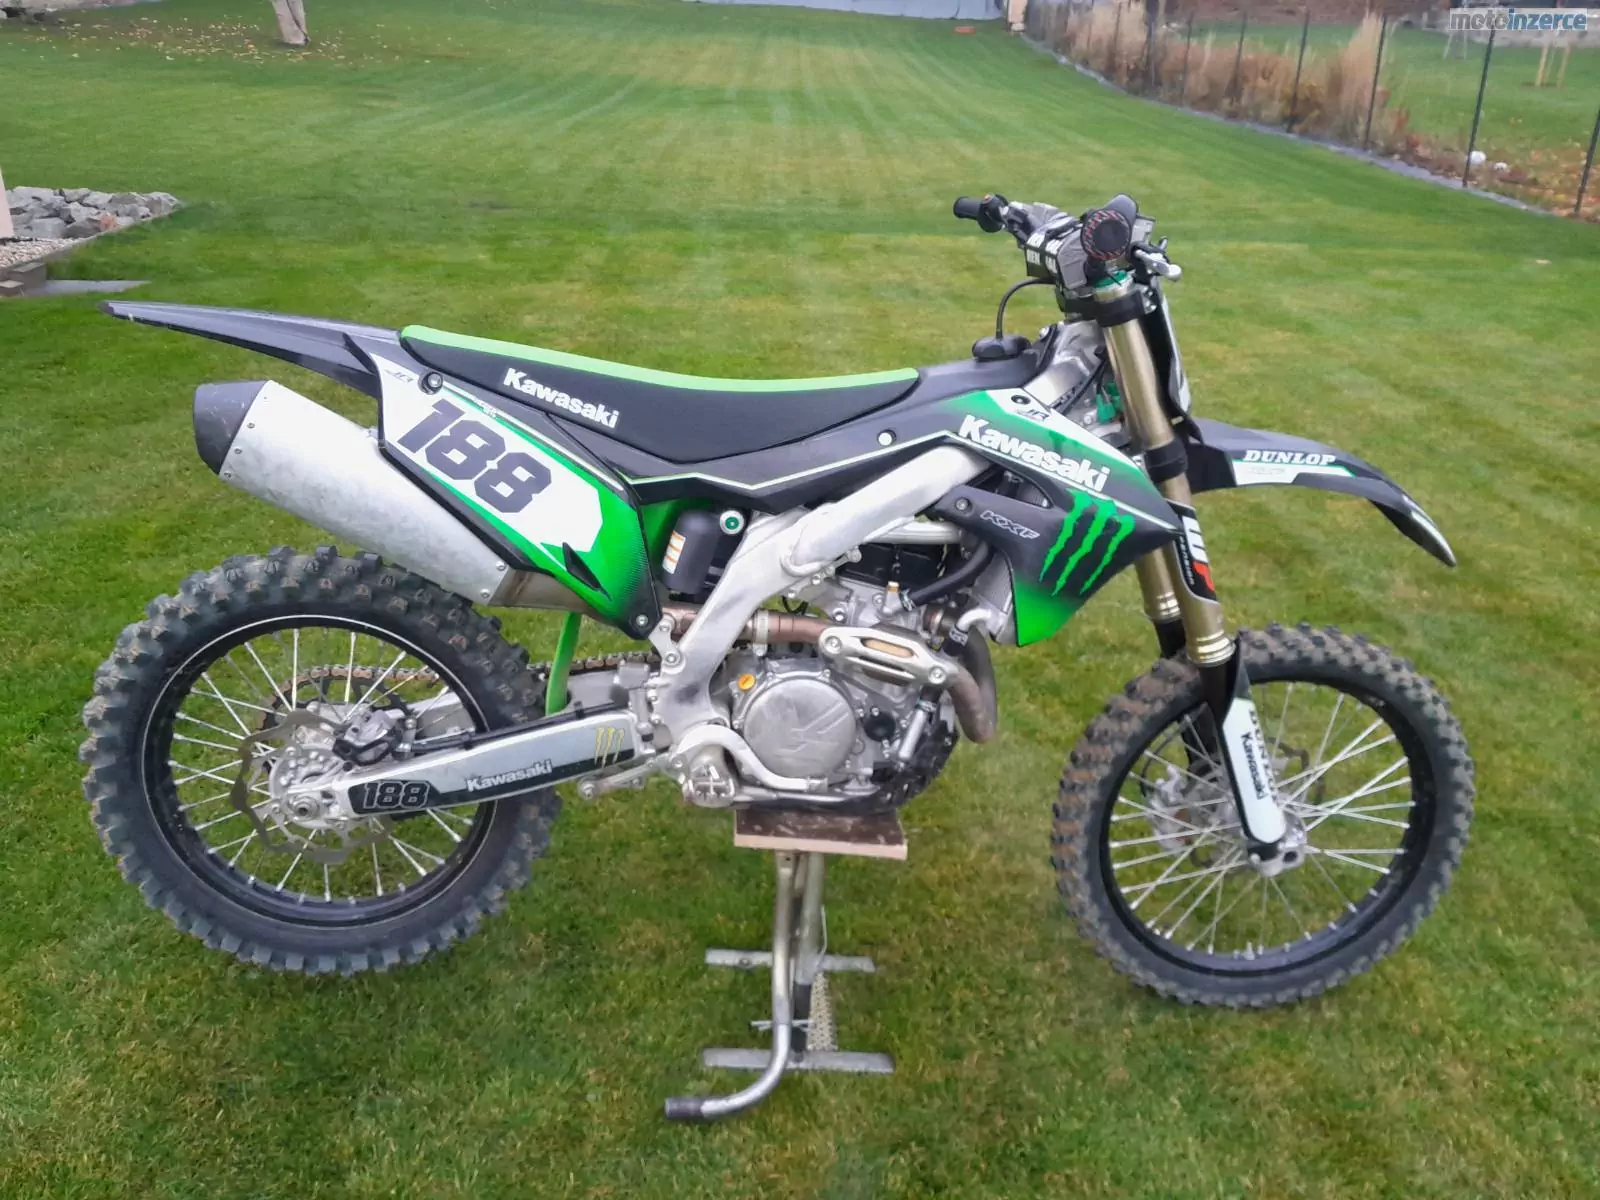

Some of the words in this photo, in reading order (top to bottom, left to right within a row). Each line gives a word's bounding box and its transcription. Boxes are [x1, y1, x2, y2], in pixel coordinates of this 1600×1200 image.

[503, 367, 620, 429] Kawasaki
[397, 398, 552, 513] 188
[958, 415, 1110, 490] Kawasaki
[1242, 449, 1336, 466] DUNLOP
[980, 510, 1040, 539] KXF
[466, 760, 553, 793] Kawasaki
[1241, 732, 1268, 801] Kawasaki
[363, 780, 430, 809] 188
